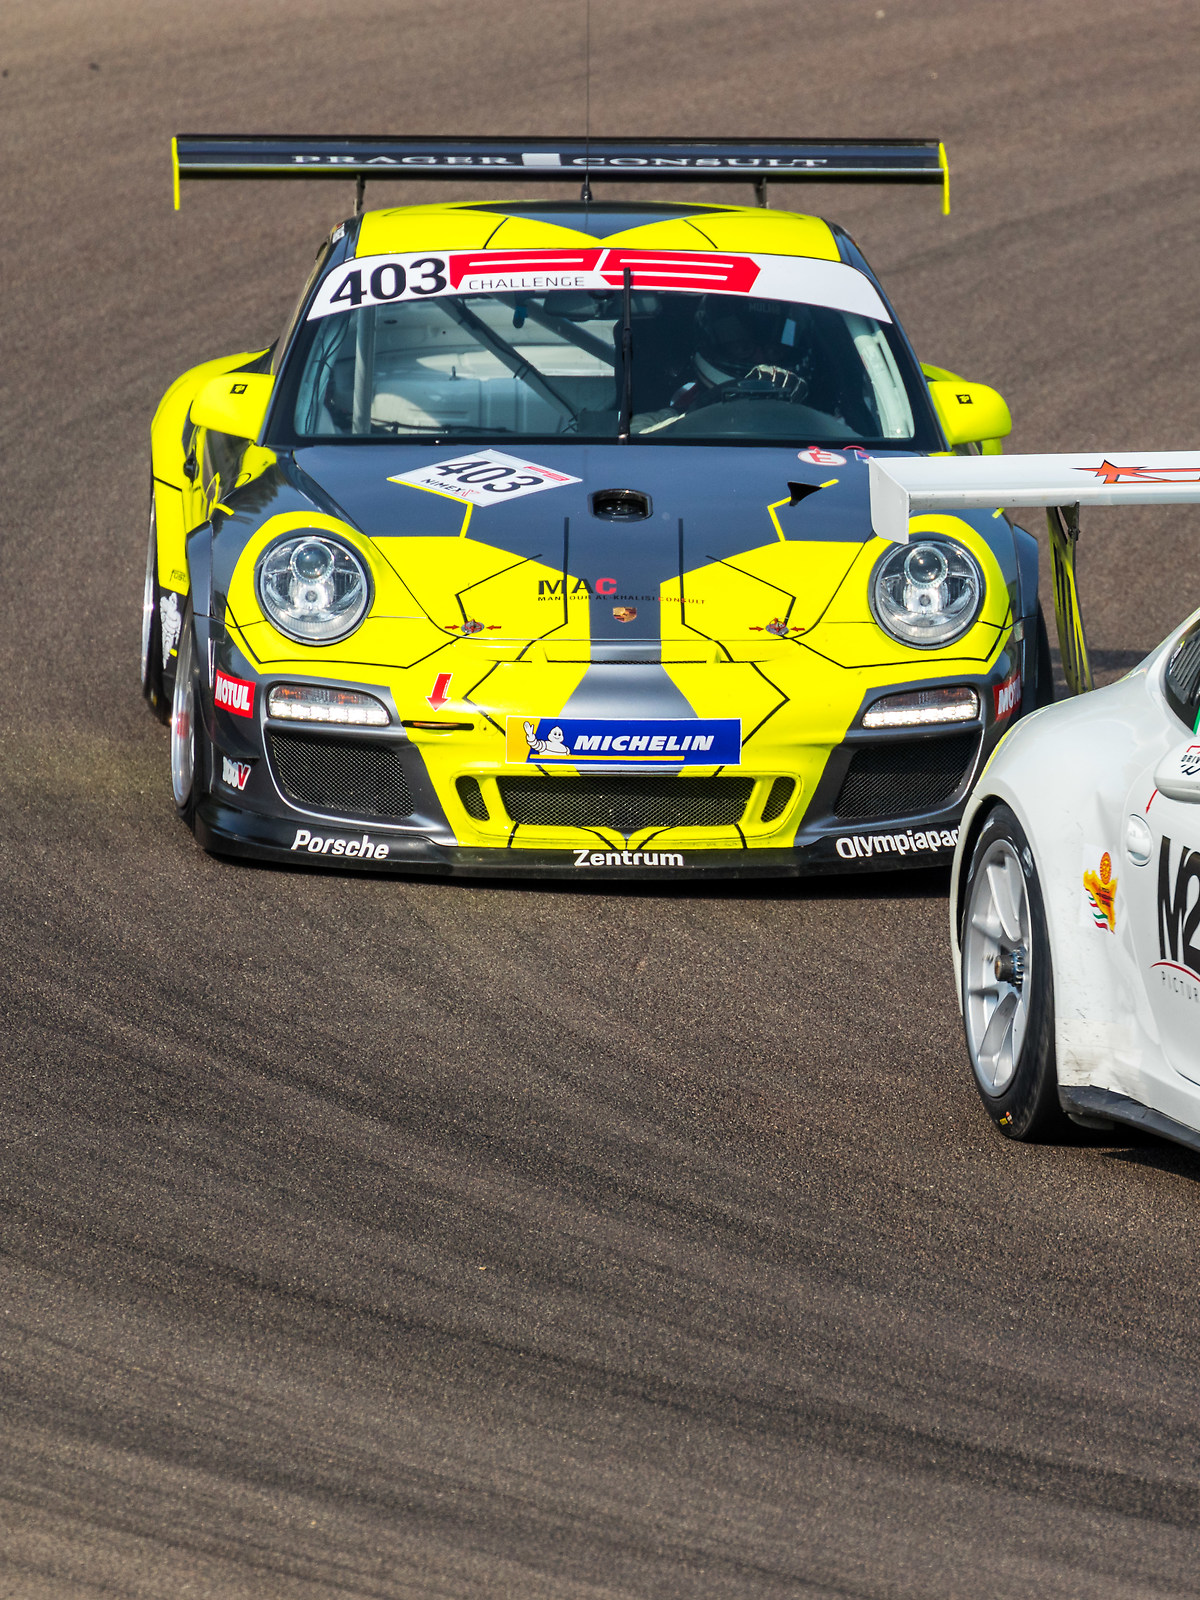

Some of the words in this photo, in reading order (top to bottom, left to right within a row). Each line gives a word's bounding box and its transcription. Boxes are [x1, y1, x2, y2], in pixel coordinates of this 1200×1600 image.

[292, 155, 514, 164] PRAGER
[572, 157, 828, 167] CONSULT
[330, 259, 449, 306] 403
[468, 275, 585, 291] CHALLENGE
[435, 460, 545, 493] 403
[538, 577, 617, 595] MAC
[215, 676, 251, 711] MOTUL
[573, 735, 715, 751] MICHELIN
[290, 829, 390, 860] Porsche
[835, 825, 961, 859] Olympiapar
[573, 849, 684, 867] Zentrum
